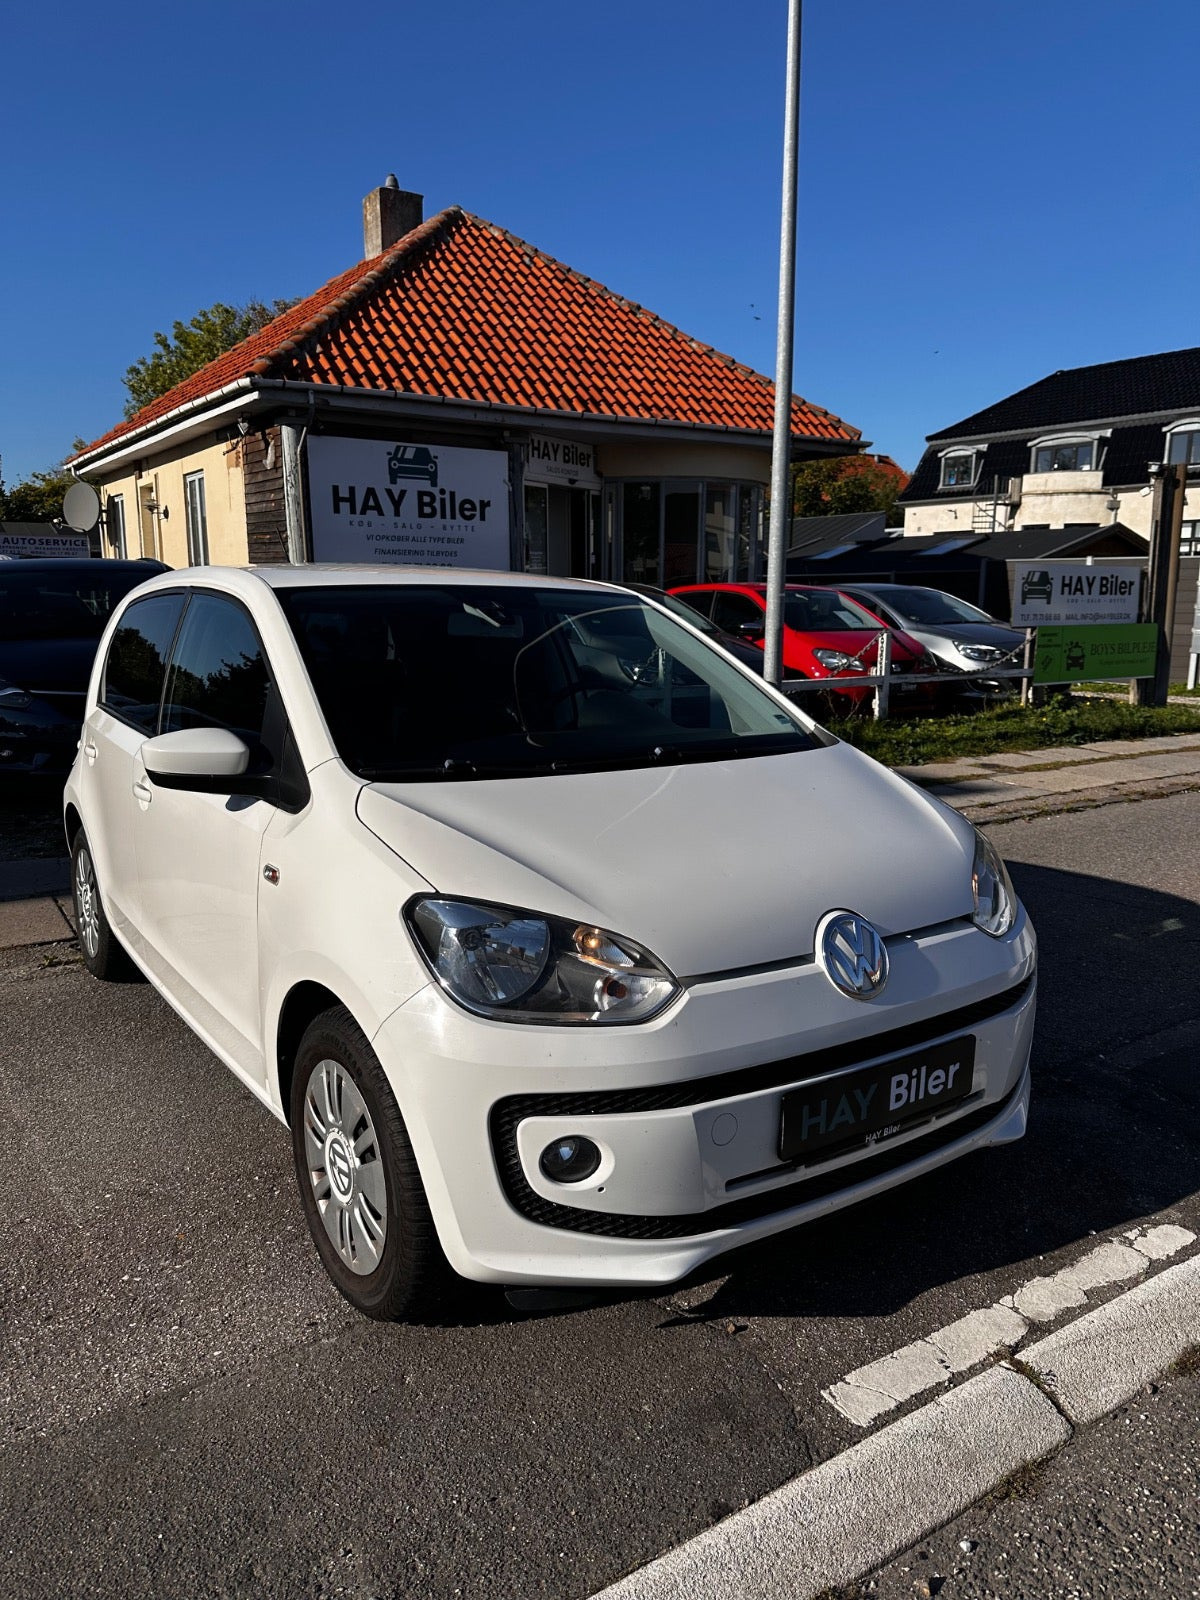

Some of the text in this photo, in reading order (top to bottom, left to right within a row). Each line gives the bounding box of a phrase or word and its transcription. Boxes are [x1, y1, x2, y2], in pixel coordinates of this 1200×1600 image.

[531, 438, 592, 468] HAY Biler
[332, 484, 491, 522] HAY Biler
[349, 520, 373, 528] KØB
[393, 522, 423, 530] SALG
[442, 524, 475, 533] BYTTE
[375, 534, 410, 543] OPKØBER
[428, 536, 445, 544] TYPE
[446, 537, 465, 545] BILER
[374, 548, 458, 558] FINANSIERING TILBYDES
[1060, 574, 1135, 596] HAY Biler
[801, 1062, 960, 1141] HAY Biler
[865, 1124, 900, 1143] HAY Biler
